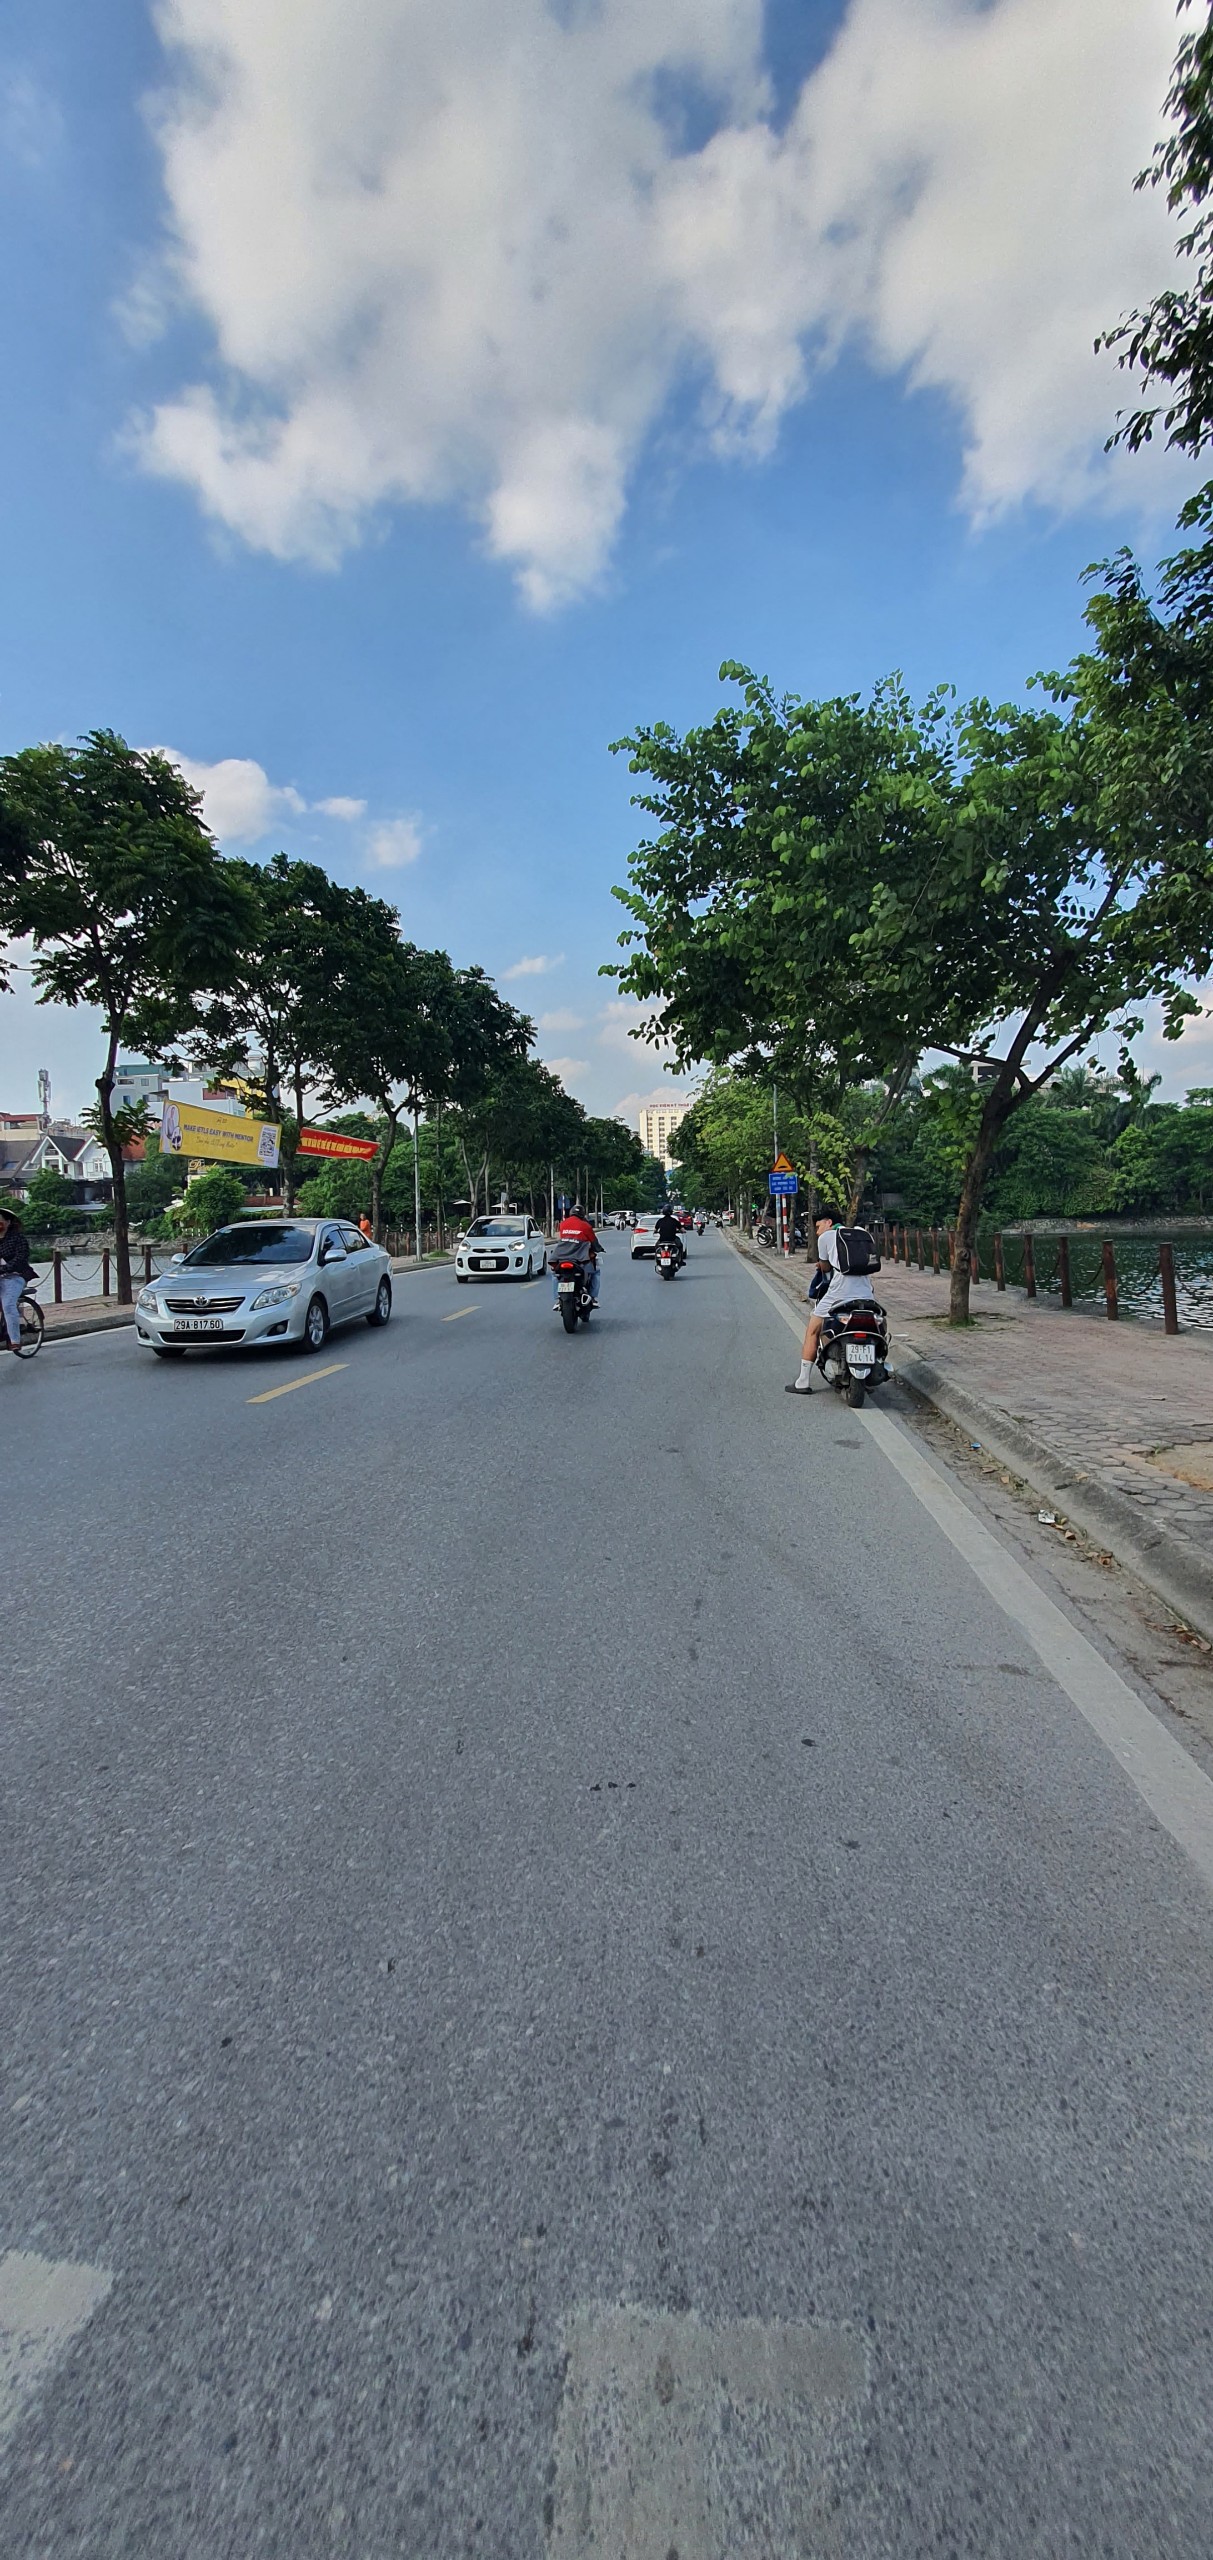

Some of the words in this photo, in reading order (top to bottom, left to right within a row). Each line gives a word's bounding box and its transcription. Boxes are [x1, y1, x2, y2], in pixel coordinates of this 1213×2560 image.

[183, 1124, 196, 1132] MAKE
[208, 1128, 221, 1136] EASY
[222, 1130, 235, 1138] WITH
[234, 1132, 254, 1142] MENTOR
[851, 1345, 871, 1354] 29-F1
